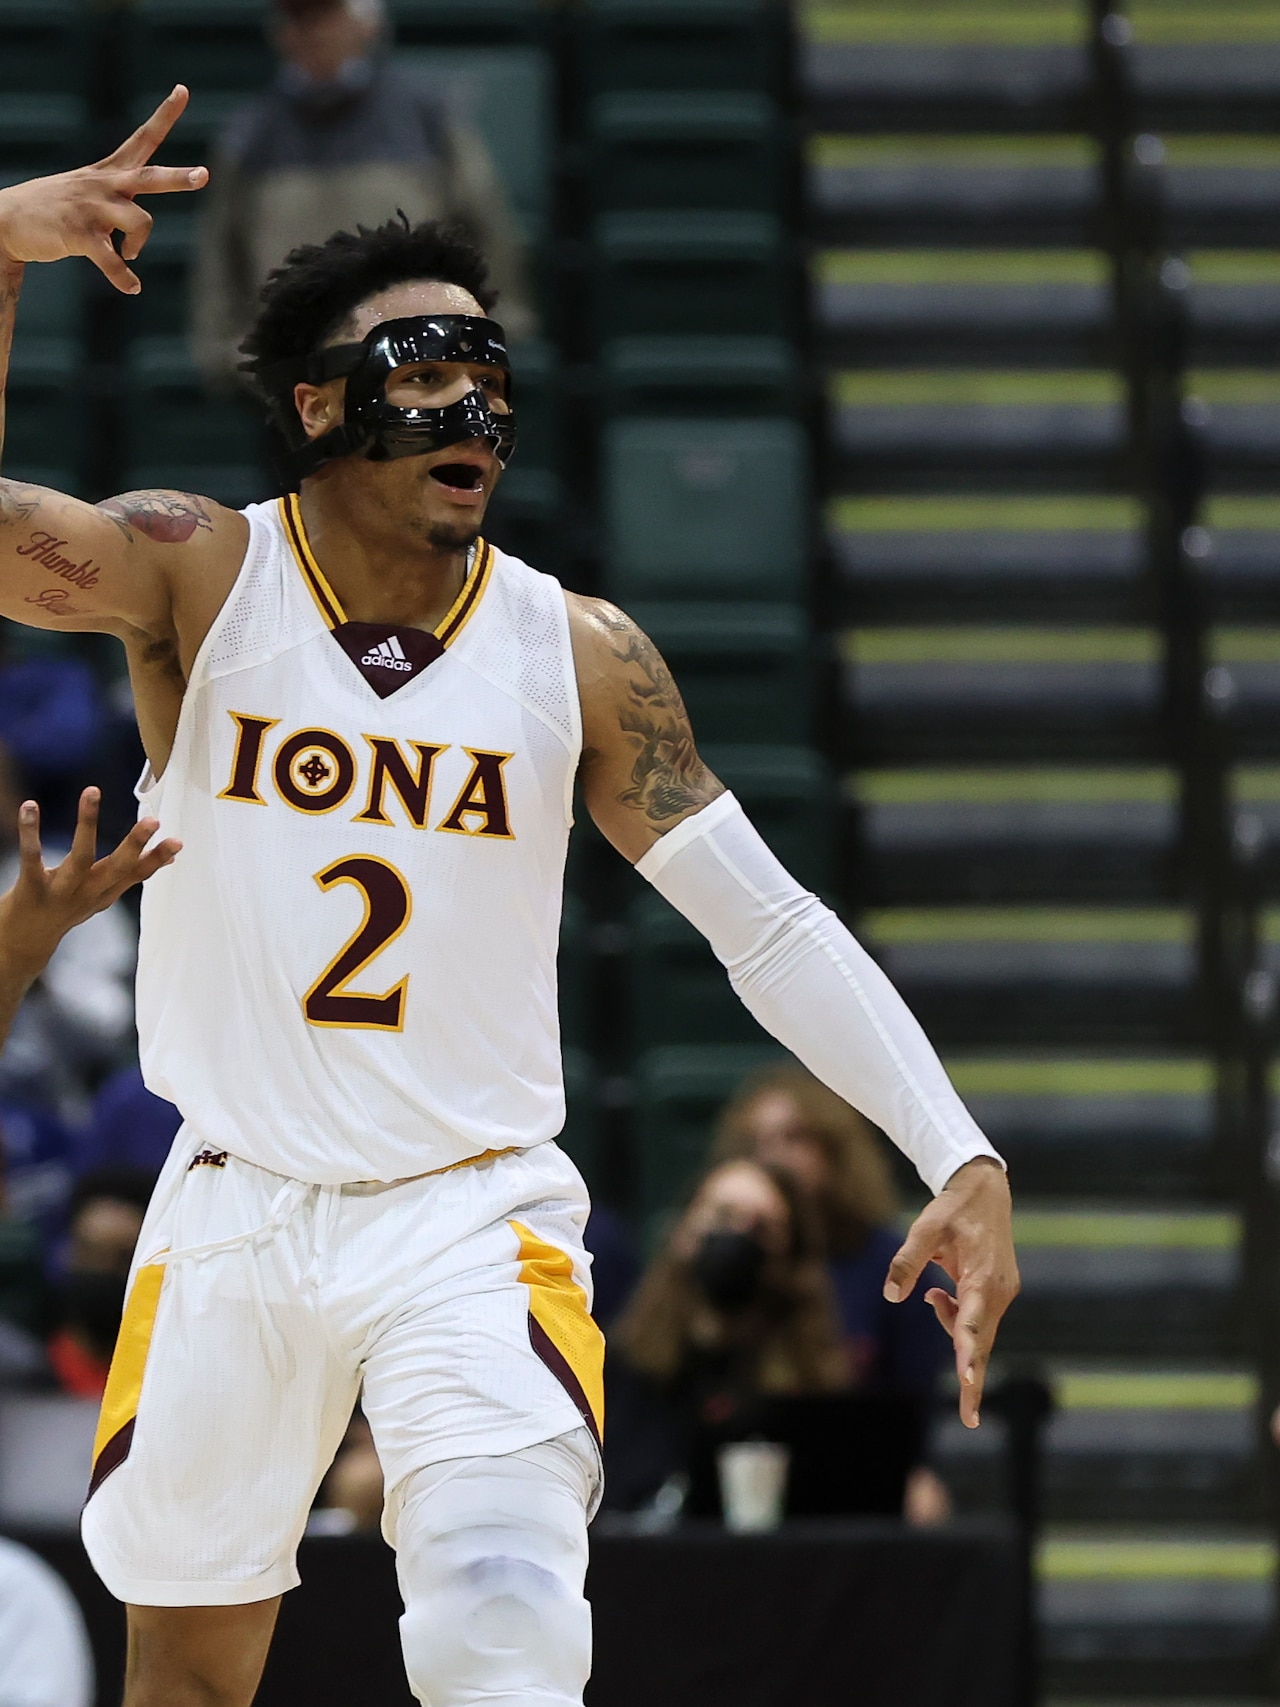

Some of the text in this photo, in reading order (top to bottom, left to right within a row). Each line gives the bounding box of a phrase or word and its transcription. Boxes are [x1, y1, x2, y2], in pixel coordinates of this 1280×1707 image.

[16, 531, 100, 590] Humble
[361, 655, 413, 672] adidas
[215, 709, 517, 841] IONA
[301, 853, 413, 1033] 2
